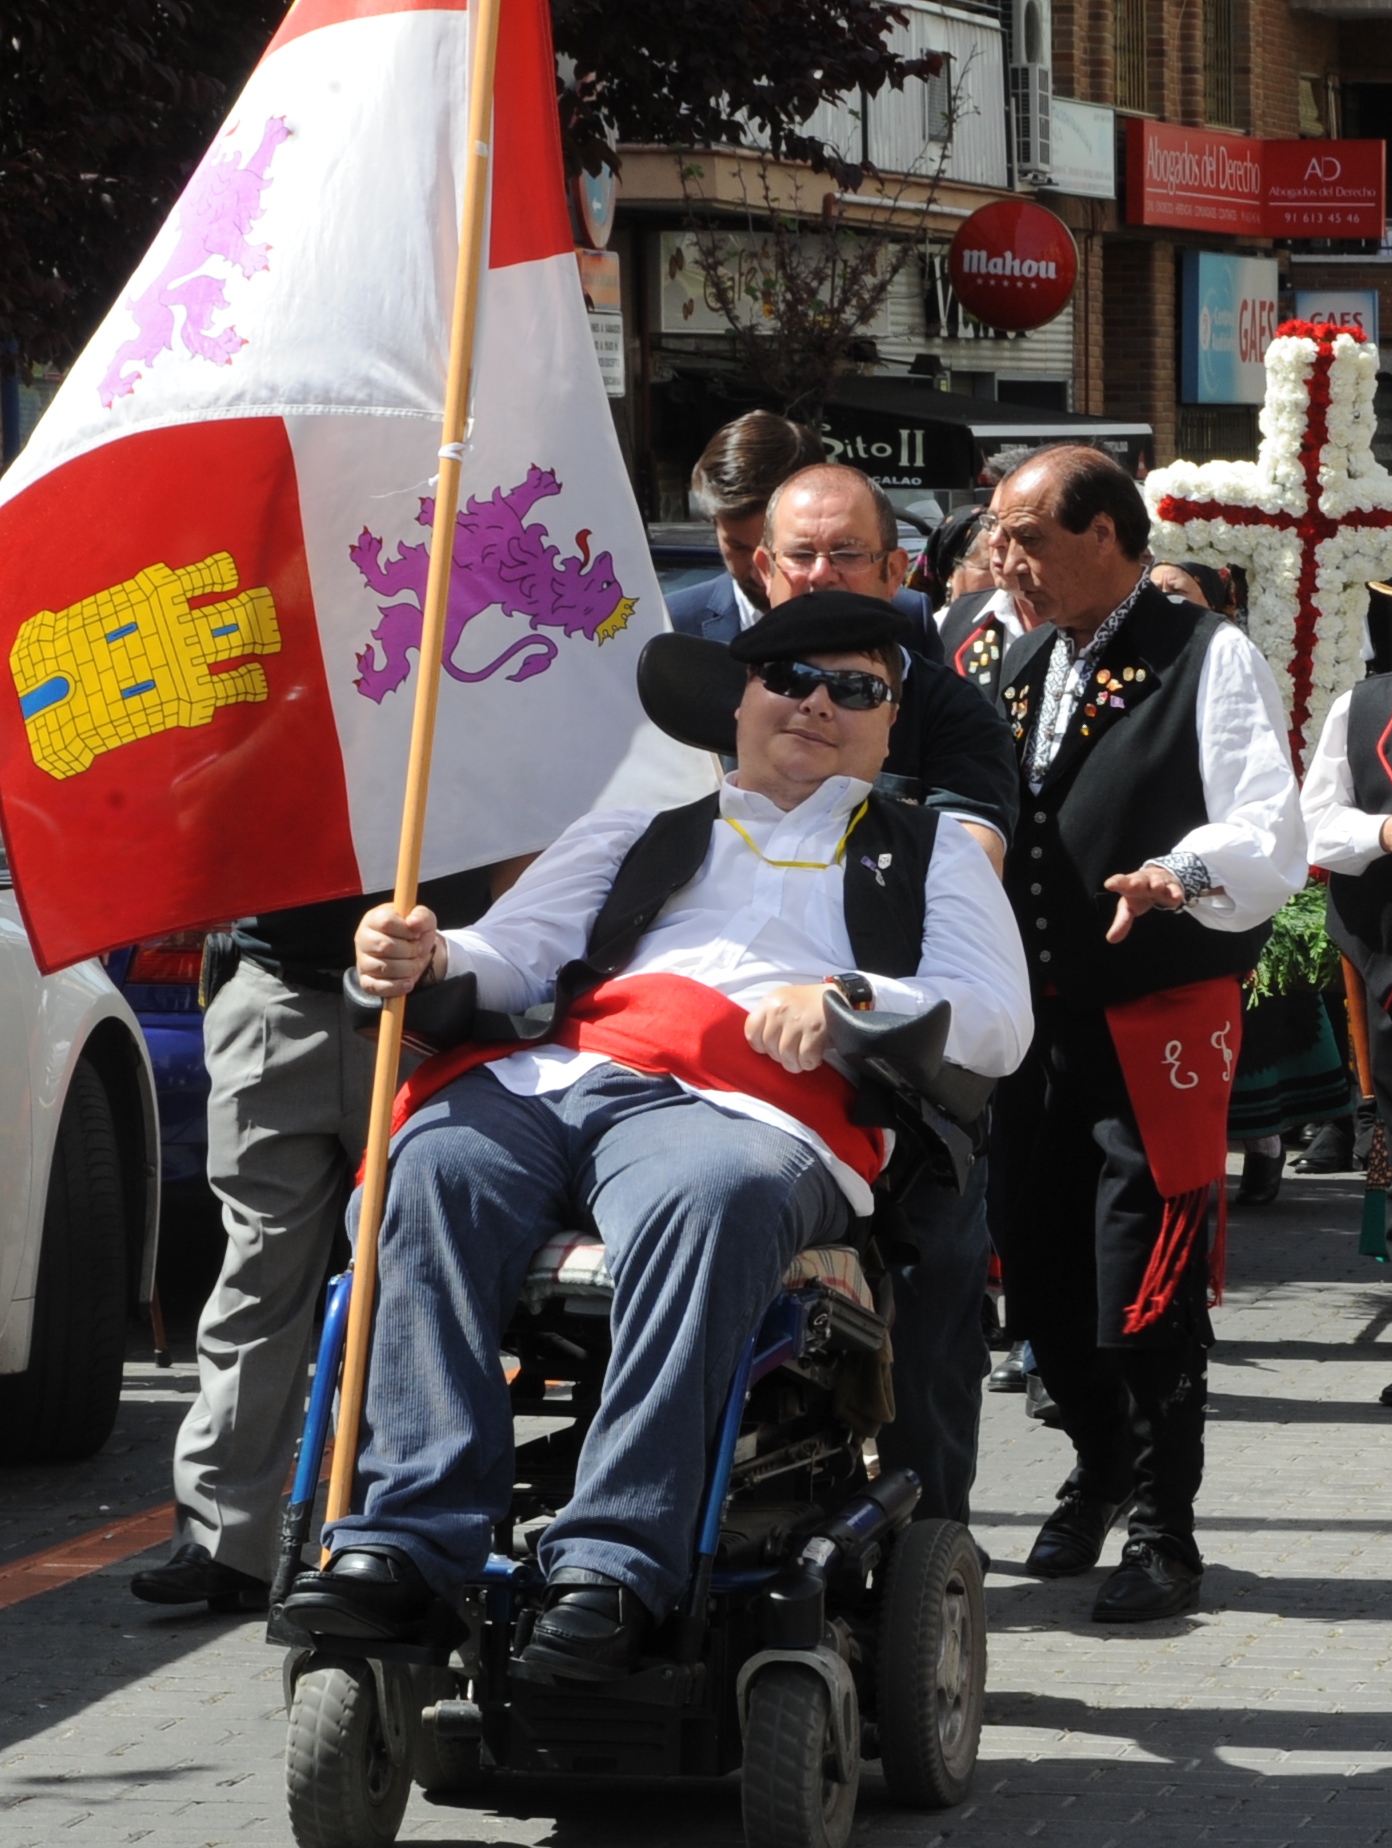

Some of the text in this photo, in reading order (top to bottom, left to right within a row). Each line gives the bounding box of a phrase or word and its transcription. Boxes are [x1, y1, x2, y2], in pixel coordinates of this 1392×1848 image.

[1146, 136, 1200, 195] Abogados
[1201, 144, 1217, 188] del
[1219, 146, 1261, 194] Derecho
[1304, 156, 1341, 182] AD
[1268, 186, 1376, 198] Abogados del Derecho
[1284, 212, 1360, 223] 91 613 45 46
[963, 249, 1057, 279] Mahou
[1239, 298, 1275, 363] GAES
[898, 429, 925, 467] II
